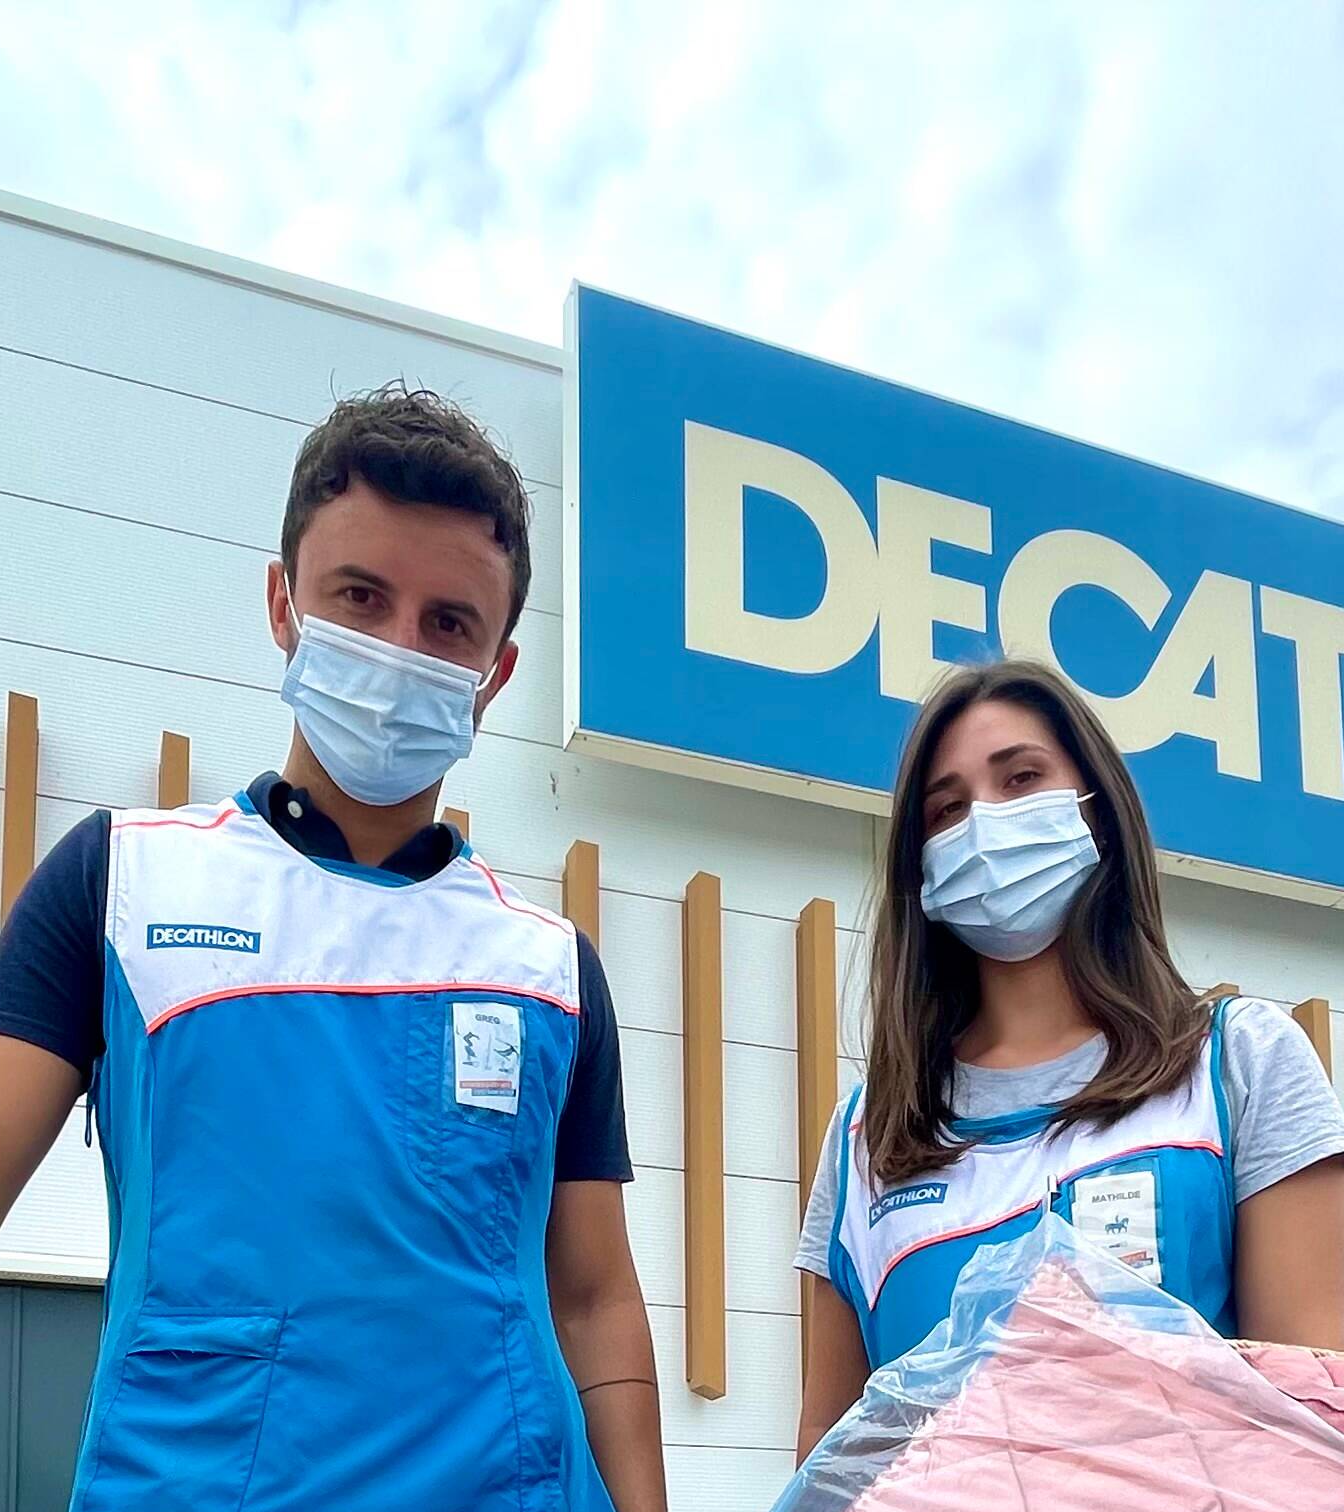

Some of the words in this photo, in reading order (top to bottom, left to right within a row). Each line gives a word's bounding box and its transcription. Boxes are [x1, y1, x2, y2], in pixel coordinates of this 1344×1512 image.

[152, 927, 255, 949] DECATHLON
[474, 1013, 502, 1026] GREG
[1091, 1190, 1142, 1204] MATHILDE
